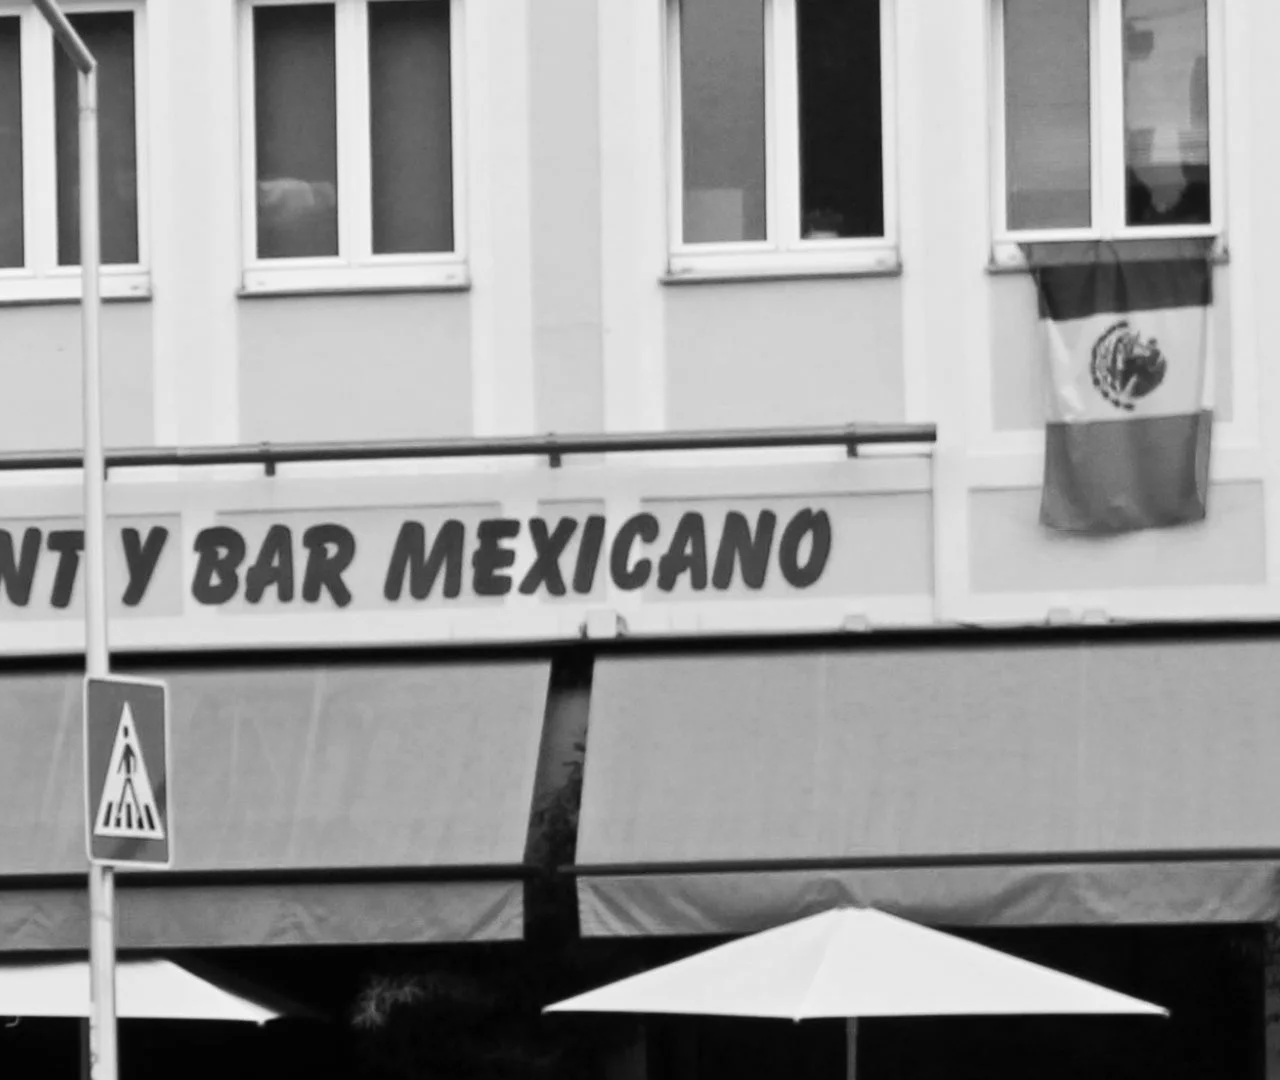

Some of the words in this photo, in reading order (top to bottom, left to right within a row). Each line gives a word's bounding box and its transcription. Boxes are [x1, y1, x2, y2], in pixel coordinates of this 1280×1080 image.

[120, 526, 169, 607] Y
[190, 523, 356, 608] BAR
[383, 506, 832, 601] MEXICANO
